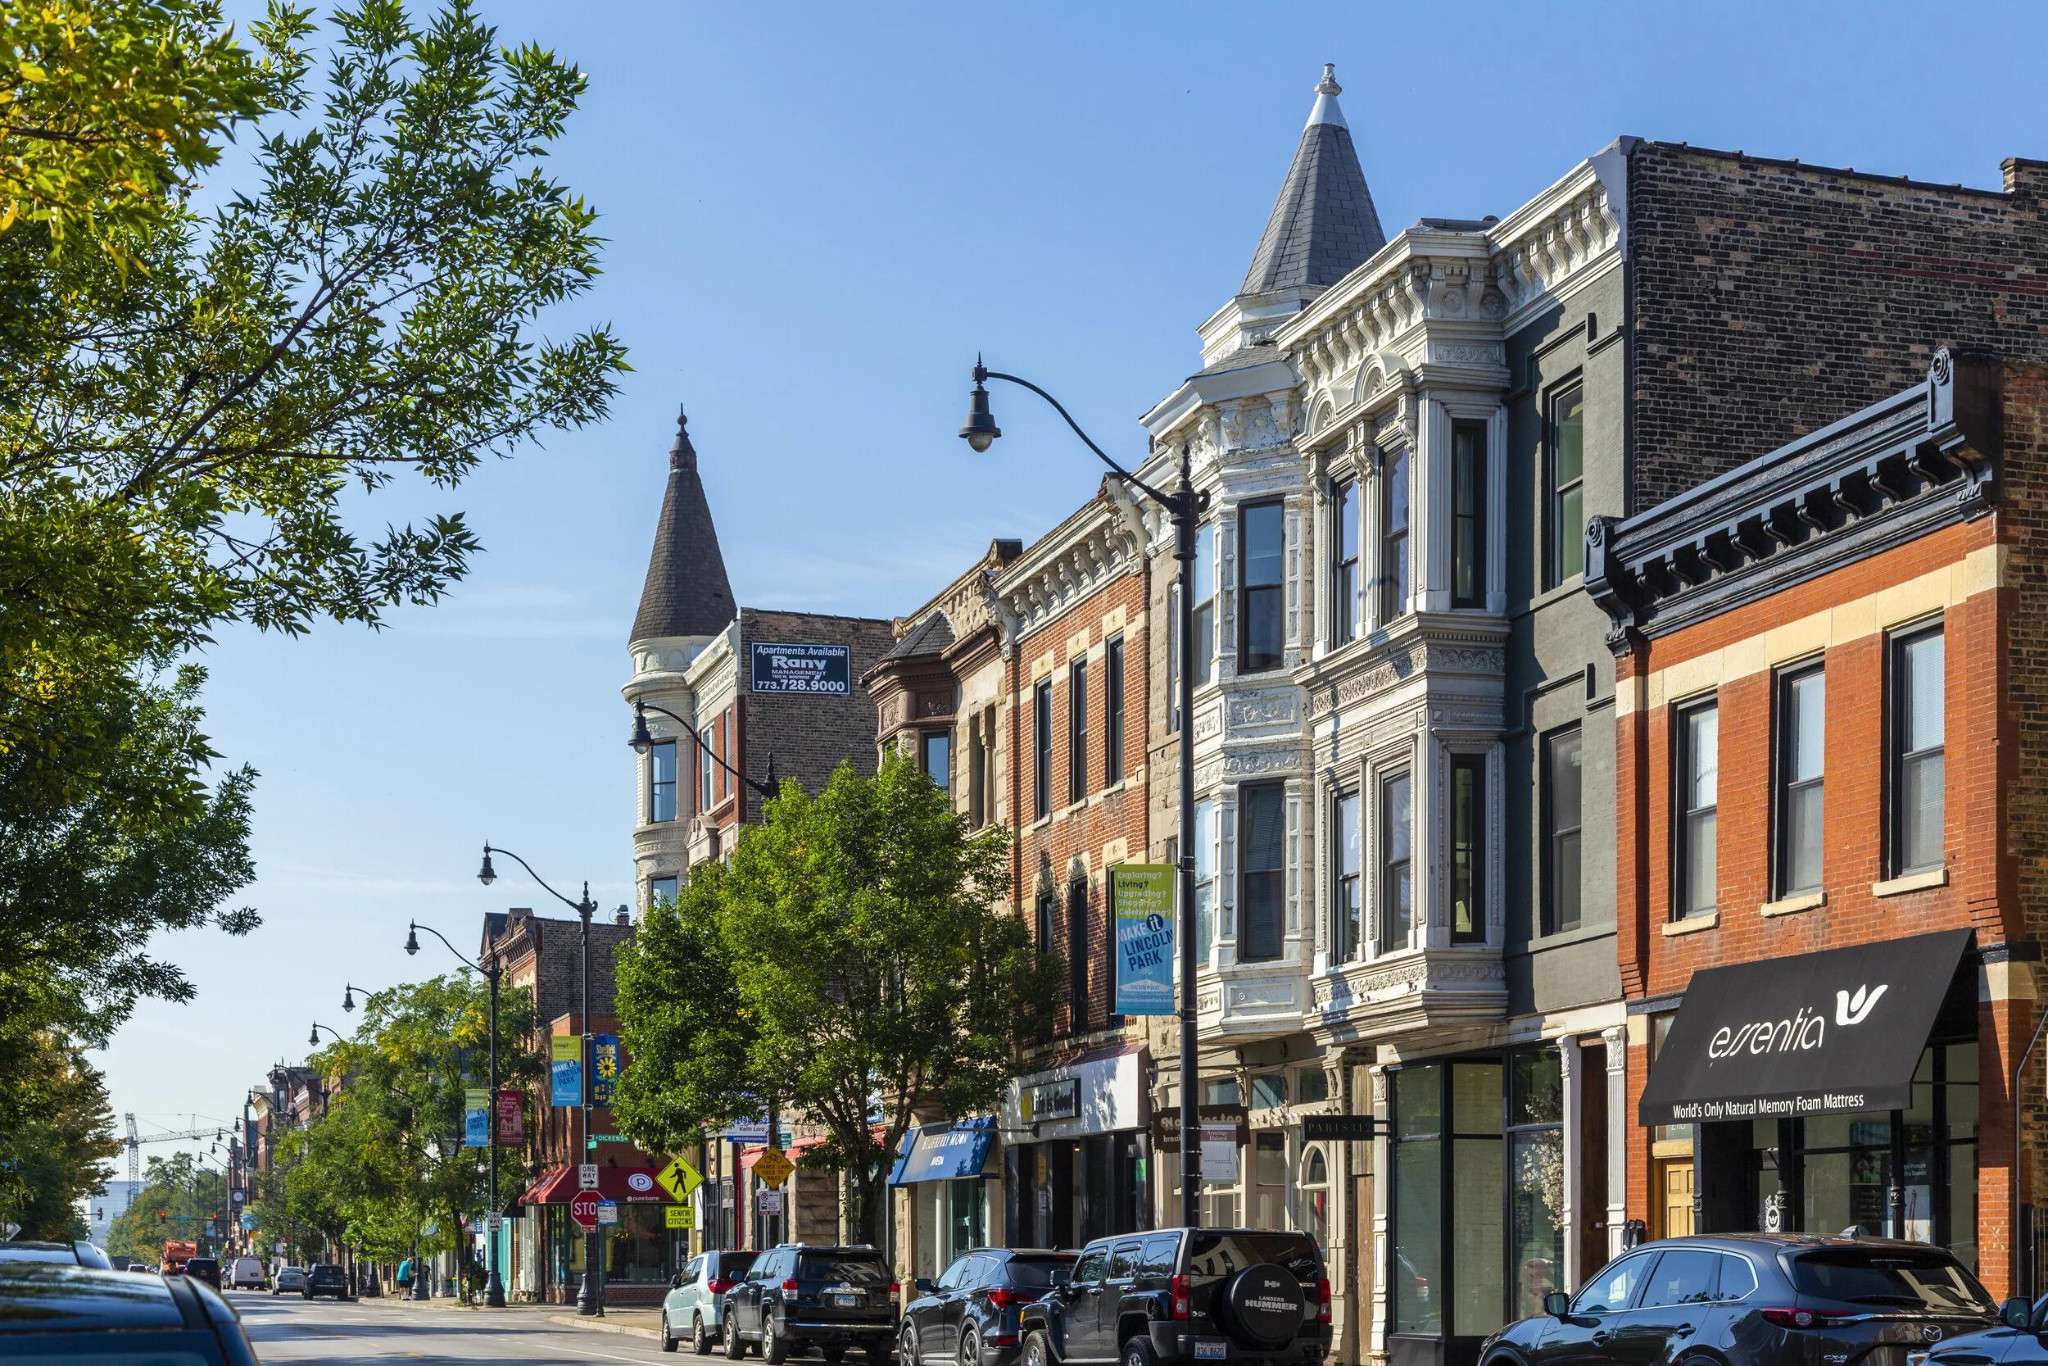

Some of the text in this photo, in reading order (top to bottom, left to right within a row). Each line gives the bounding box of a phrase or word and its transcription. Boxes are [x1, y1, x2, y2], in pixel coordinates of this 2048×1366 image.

[757, 646, 845, 656] Apartments Available
[771, 655, 827, 670] Rany
[757, 679, 845, 691] 773.728.9000
[1118, 881, 1148, 889] Living?
[1118, 916, 1161, 941] MAKE it
[1124, 929, 1173, 956] LINCOLN
[1128, 949, 1163, 971] PARK
[1709, 1007, 1824, 1058] essentia
[559, 1077, 576, 1086] PARK
[1054, 1088, 1073, 1112] Good
[1673, 1094, 1864, 1119] World's Only Natural Memory Foam Mattress
[930, 1156, 945, 1166] AVEDA
[574, 1202, 596, 1215] STO
[1245, 1299, 1298, 1311] HUMMER
